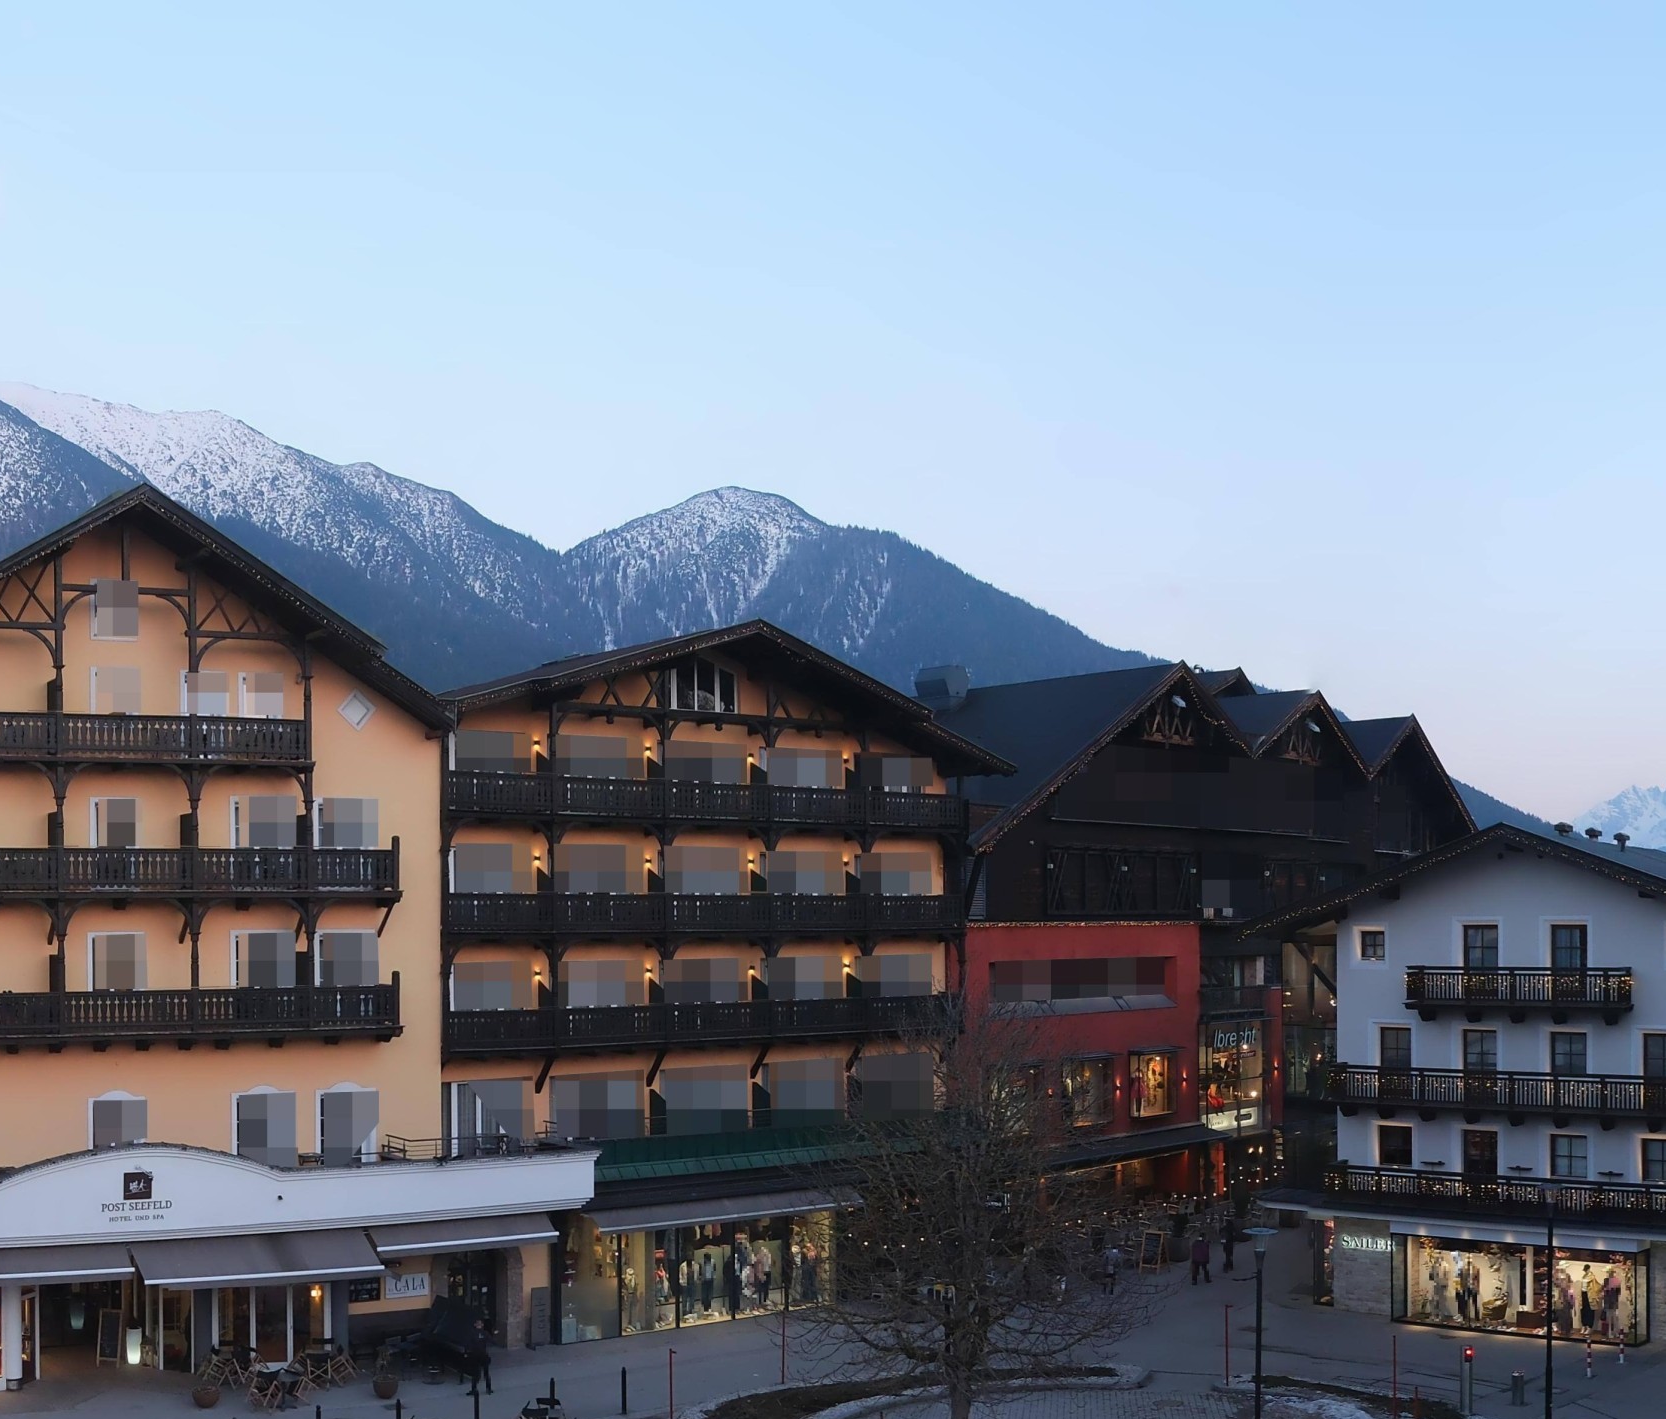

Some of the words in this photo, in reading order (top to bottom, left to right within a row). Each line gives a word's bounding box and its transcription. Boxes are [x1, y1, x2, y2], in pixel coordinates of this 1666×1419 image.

[101, 1203, 126, 1212] POST
[129, 1200, 173, 1211] SEEFELD
[394, 1276, 425, 1292] CALA
